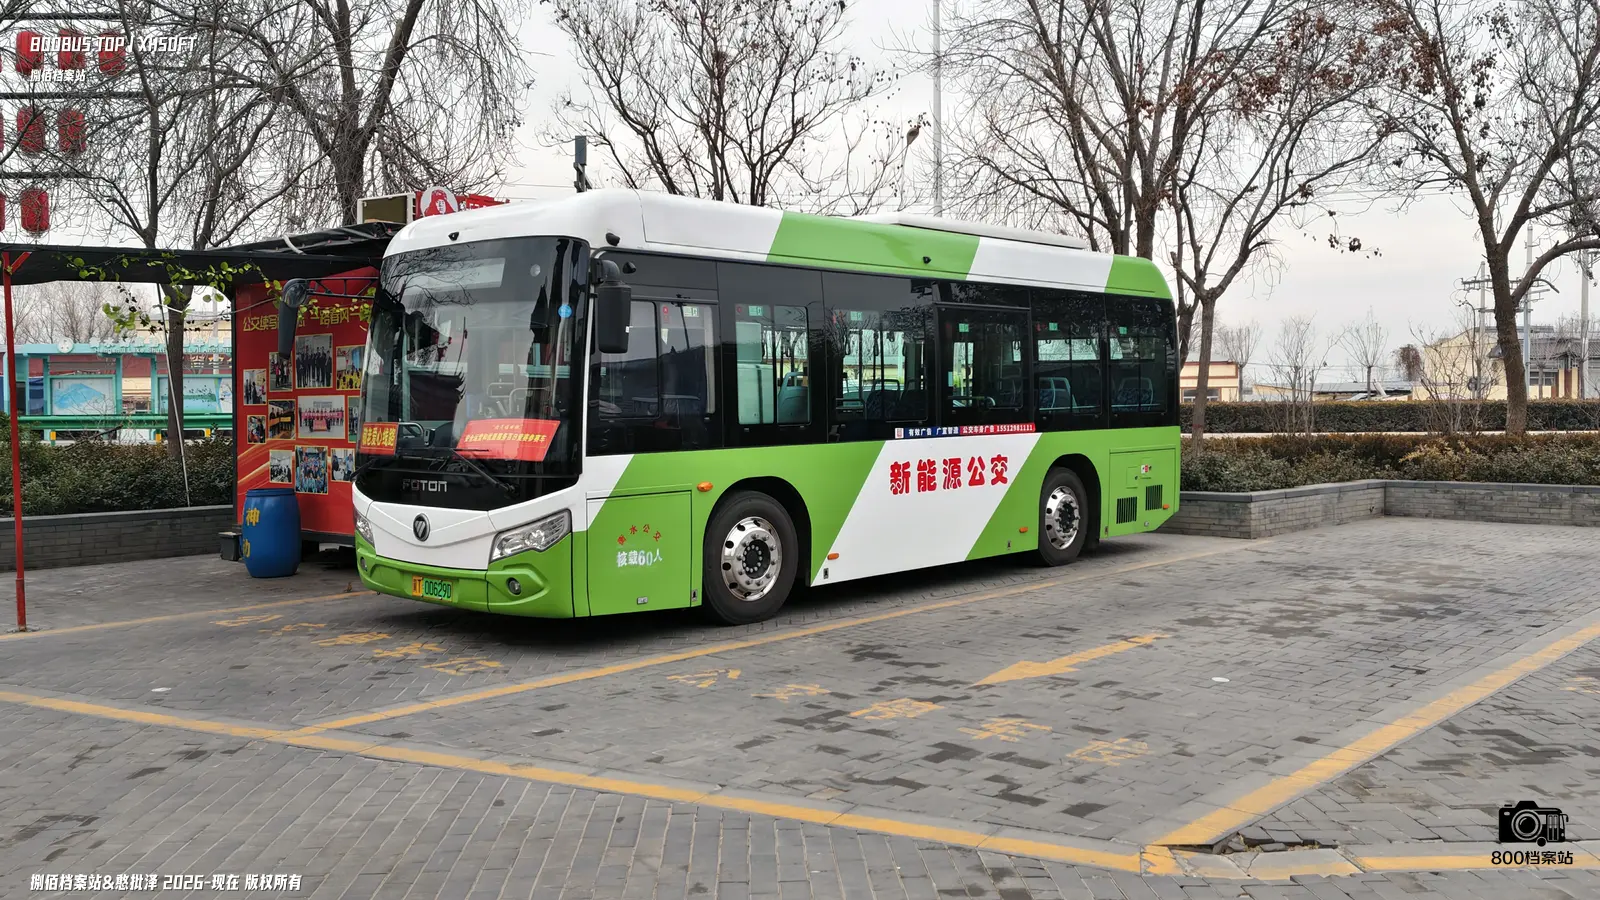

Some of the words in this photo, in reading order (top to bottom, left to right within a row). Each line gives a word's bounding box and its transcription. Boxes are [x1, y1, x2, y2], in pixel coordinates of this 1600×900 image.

[889, 454, 1009, 495] 新能源公交
[616, 548, 663, 568] 核载60人
